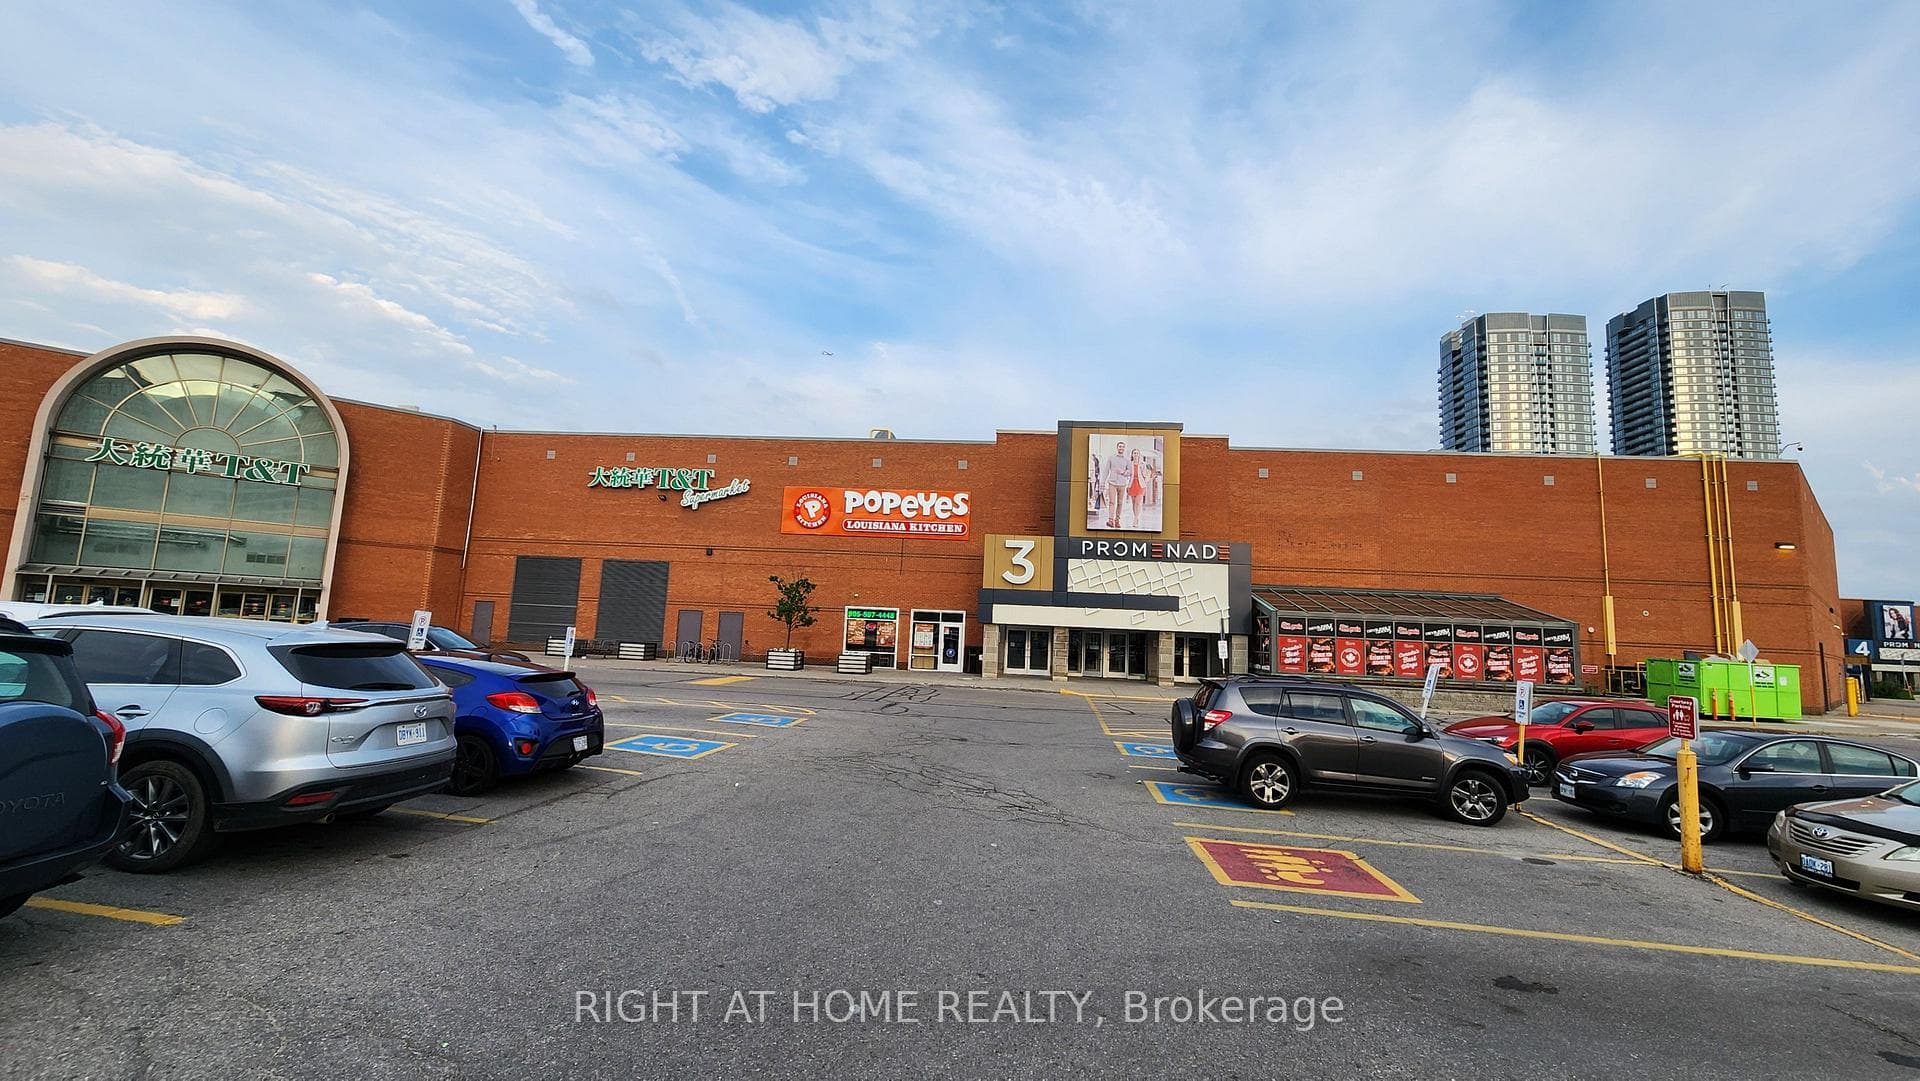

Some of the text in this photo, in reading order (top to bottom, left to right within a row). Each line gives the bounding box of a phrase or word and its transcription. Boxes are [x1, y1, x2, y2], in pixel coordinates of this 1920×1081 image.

[85, 437, 310, 485] 大統華 T&T
[588, 466, 715, 491] 大統華 T&T
[680, 478, 750, 510] Supermarket
[846, 520, 963, 533] LOUISIANA KITCHEN
[1001, 540, 1035, 585] 3
[1081, 540, 1231, 561] PROMENADE
[1855, 641, 1870, 656] 4
